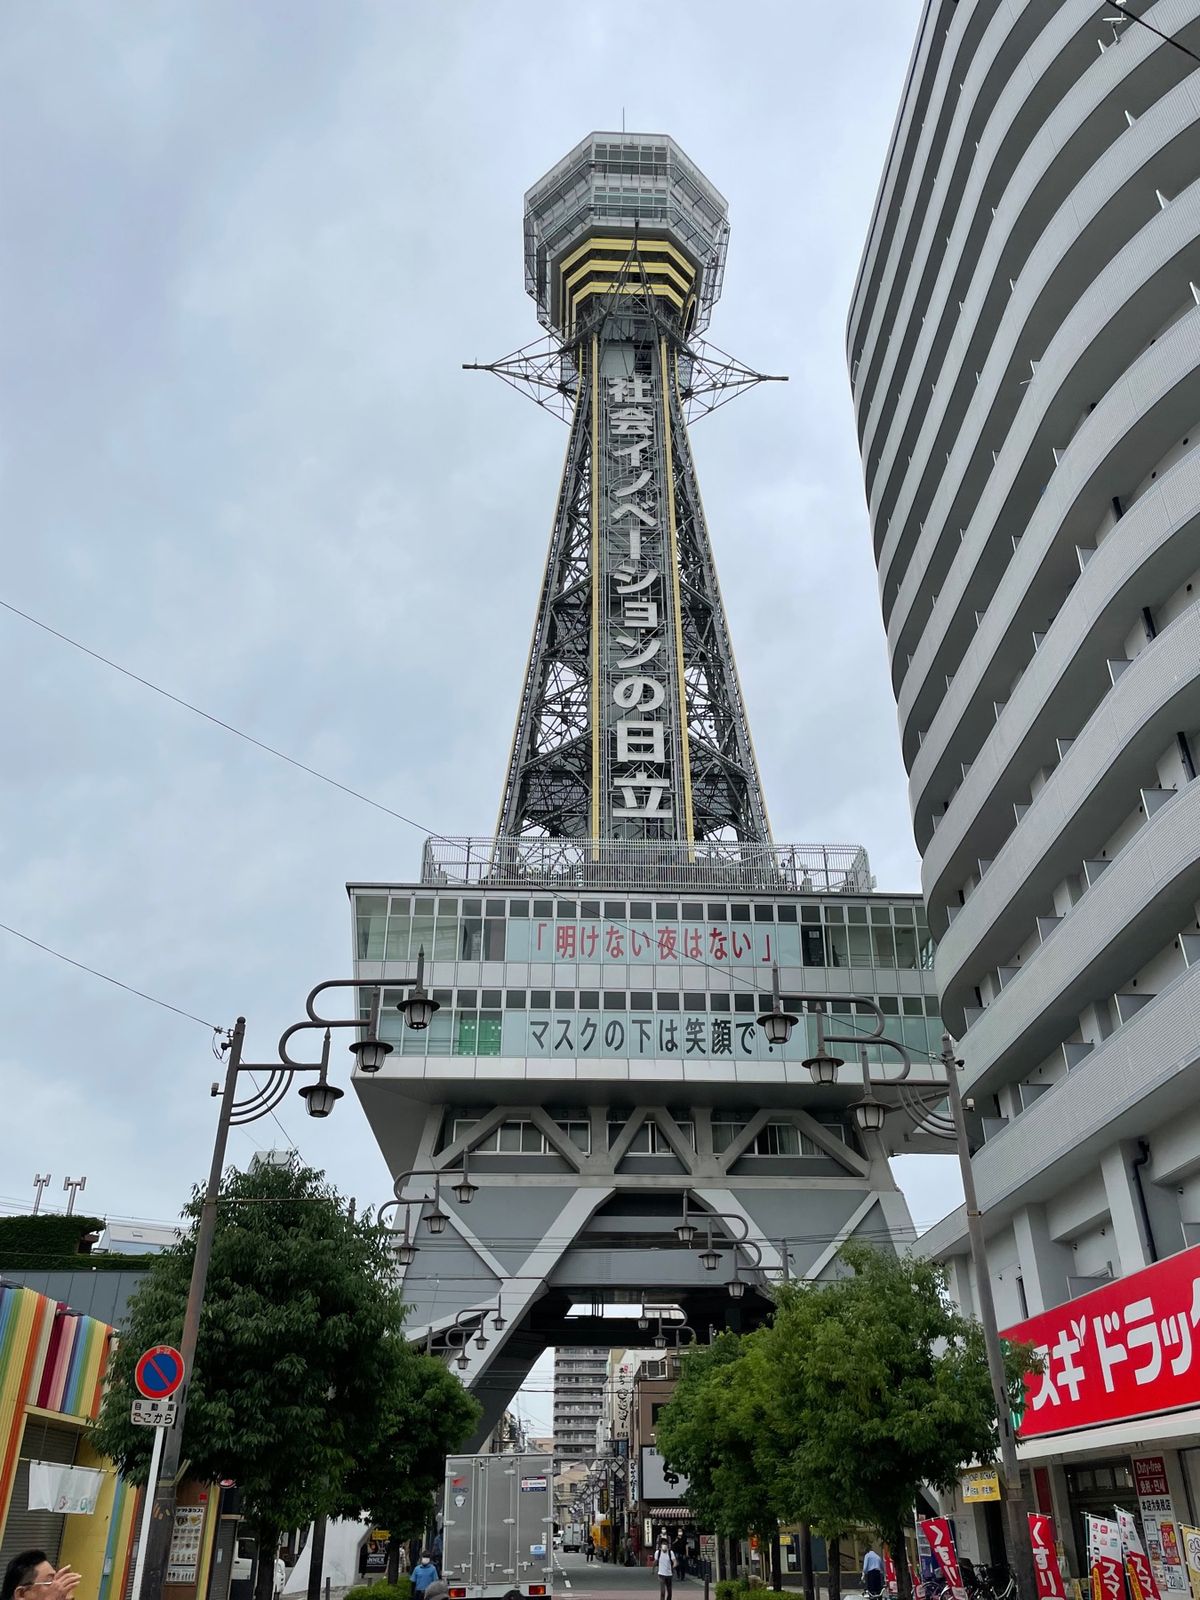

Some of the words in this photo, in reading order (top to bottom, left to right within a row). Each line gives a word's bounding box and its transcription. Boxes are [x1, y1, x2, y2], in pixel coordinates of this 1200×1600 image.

[608, 376, 672, 818] 社会イノベーションの日立
[537, 922, 771, 963] 「明けない夜はない」
[529, 1016, 775, 1055] マスクの下は笑顔で
[1031, 1278, 1200, 1412] スギドラッ
[133, 1412, 173, 1425] ここから
[134, 1402, 175, 1412] 自動車
[1136, 1460, 1162, 1476] Duty-free
[1032, 1521, 1057, 1596] くすり
[1131, 1556, 1160, 1600] スマ
[1102, 1561, 1121, 1600] スマ
